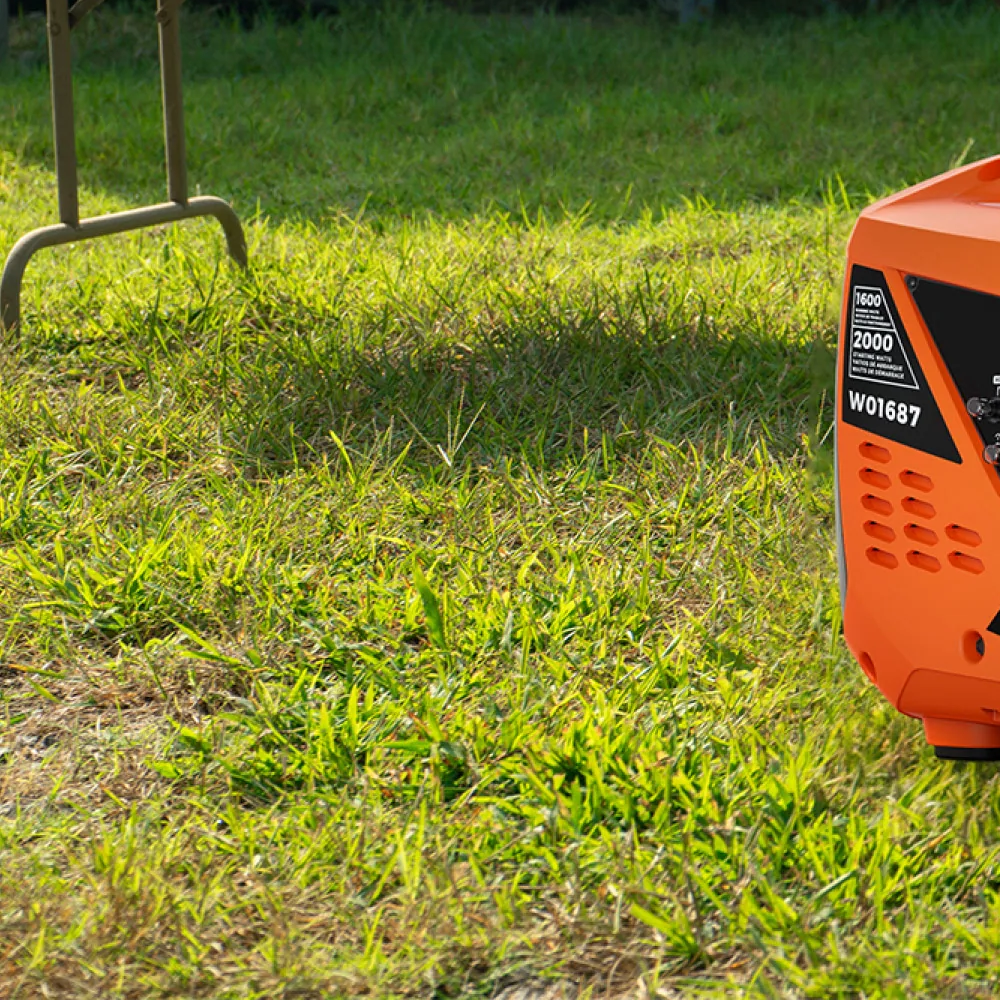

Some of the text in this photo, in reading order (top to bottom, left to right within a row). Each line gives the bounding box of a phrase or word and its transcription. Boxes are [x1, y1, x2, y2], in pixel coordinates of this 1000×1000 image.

[855, 292, 882, 308] 1600
[852, 331, 893, 352] 2000
[848, 390, 922, 428] W01687
